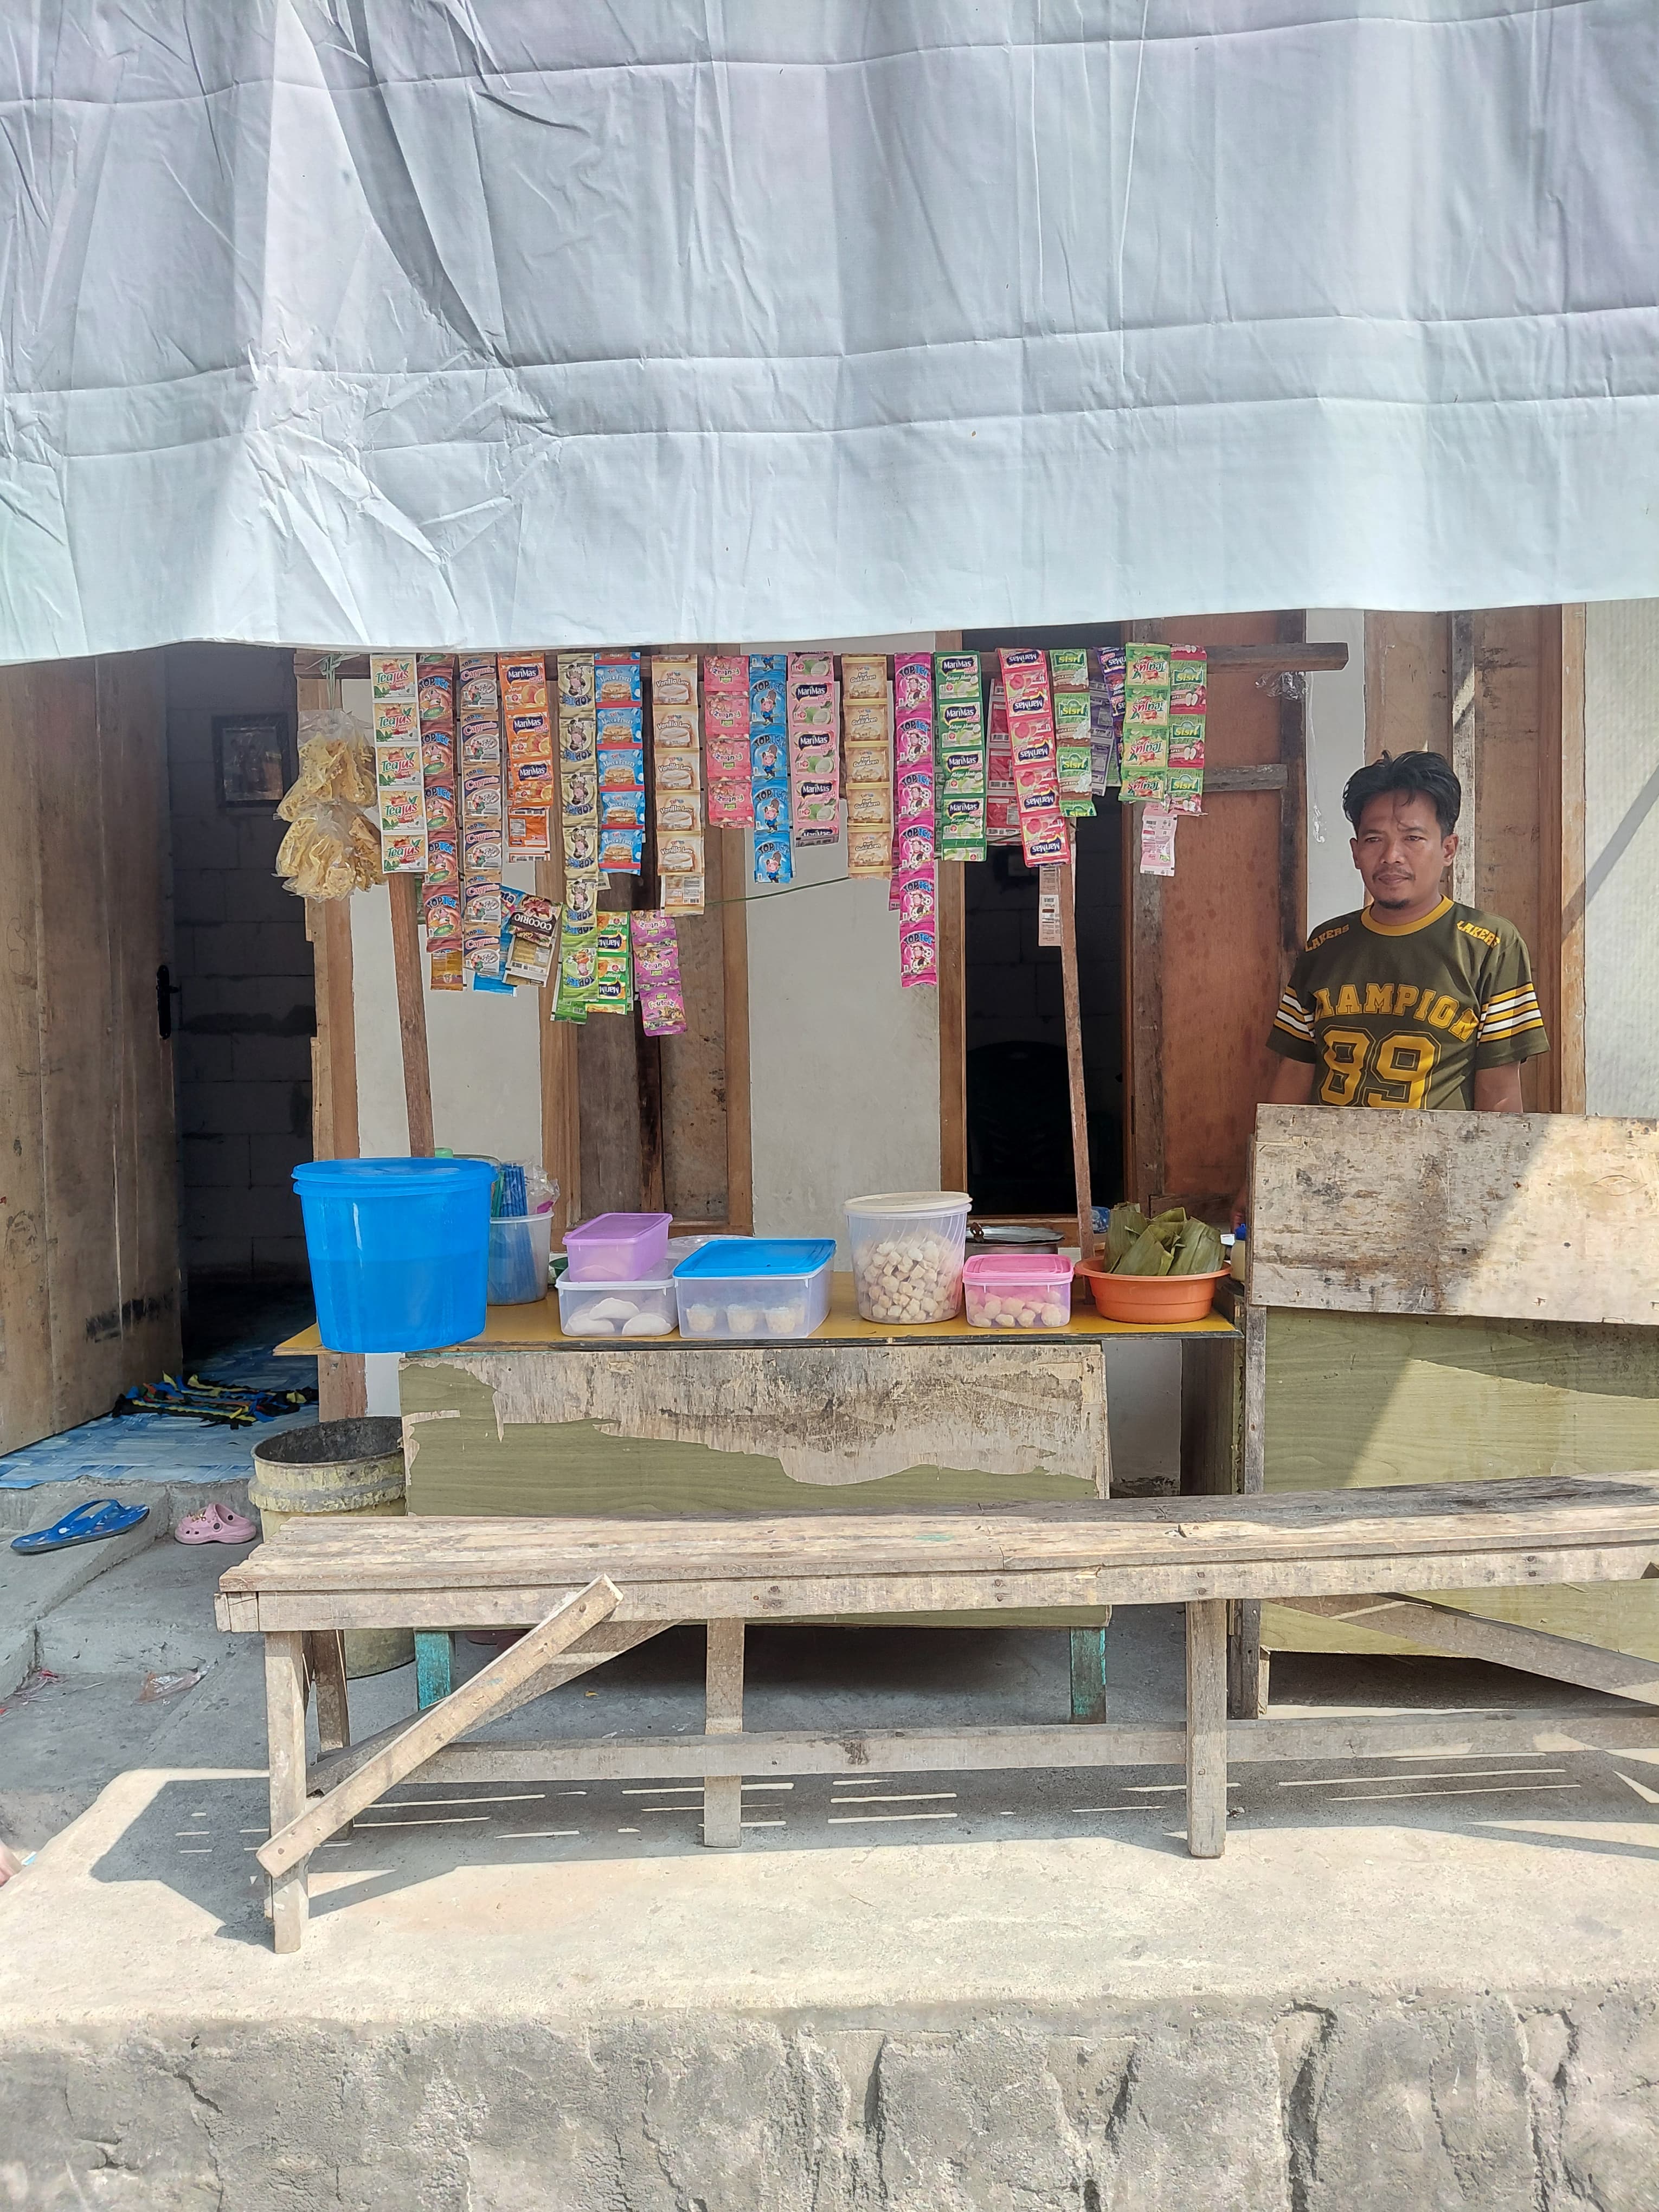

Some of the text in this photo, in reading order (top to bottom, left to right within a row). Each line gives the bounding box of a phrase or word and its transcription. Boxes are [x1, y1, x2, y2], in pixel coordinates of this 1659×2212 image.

[944, 661, 972, 669] MariMas
[798, 687, 826, 696] MariMas
[946, 709, 974, 718] MariMas
[800, 736, 828, 745] MariMas
[949, 757, 976, 766] MariMas
[803, 786, 830, 794] MariMas
[950, 803, 978, 812] MariMas
[514, 914, 552, 931] COCORIO
[1305, 923, 1349, 952] LAKERS
[1456, 920, 1500, 948] LAKERS
[1320, 1024, 1442, 1109] 89
